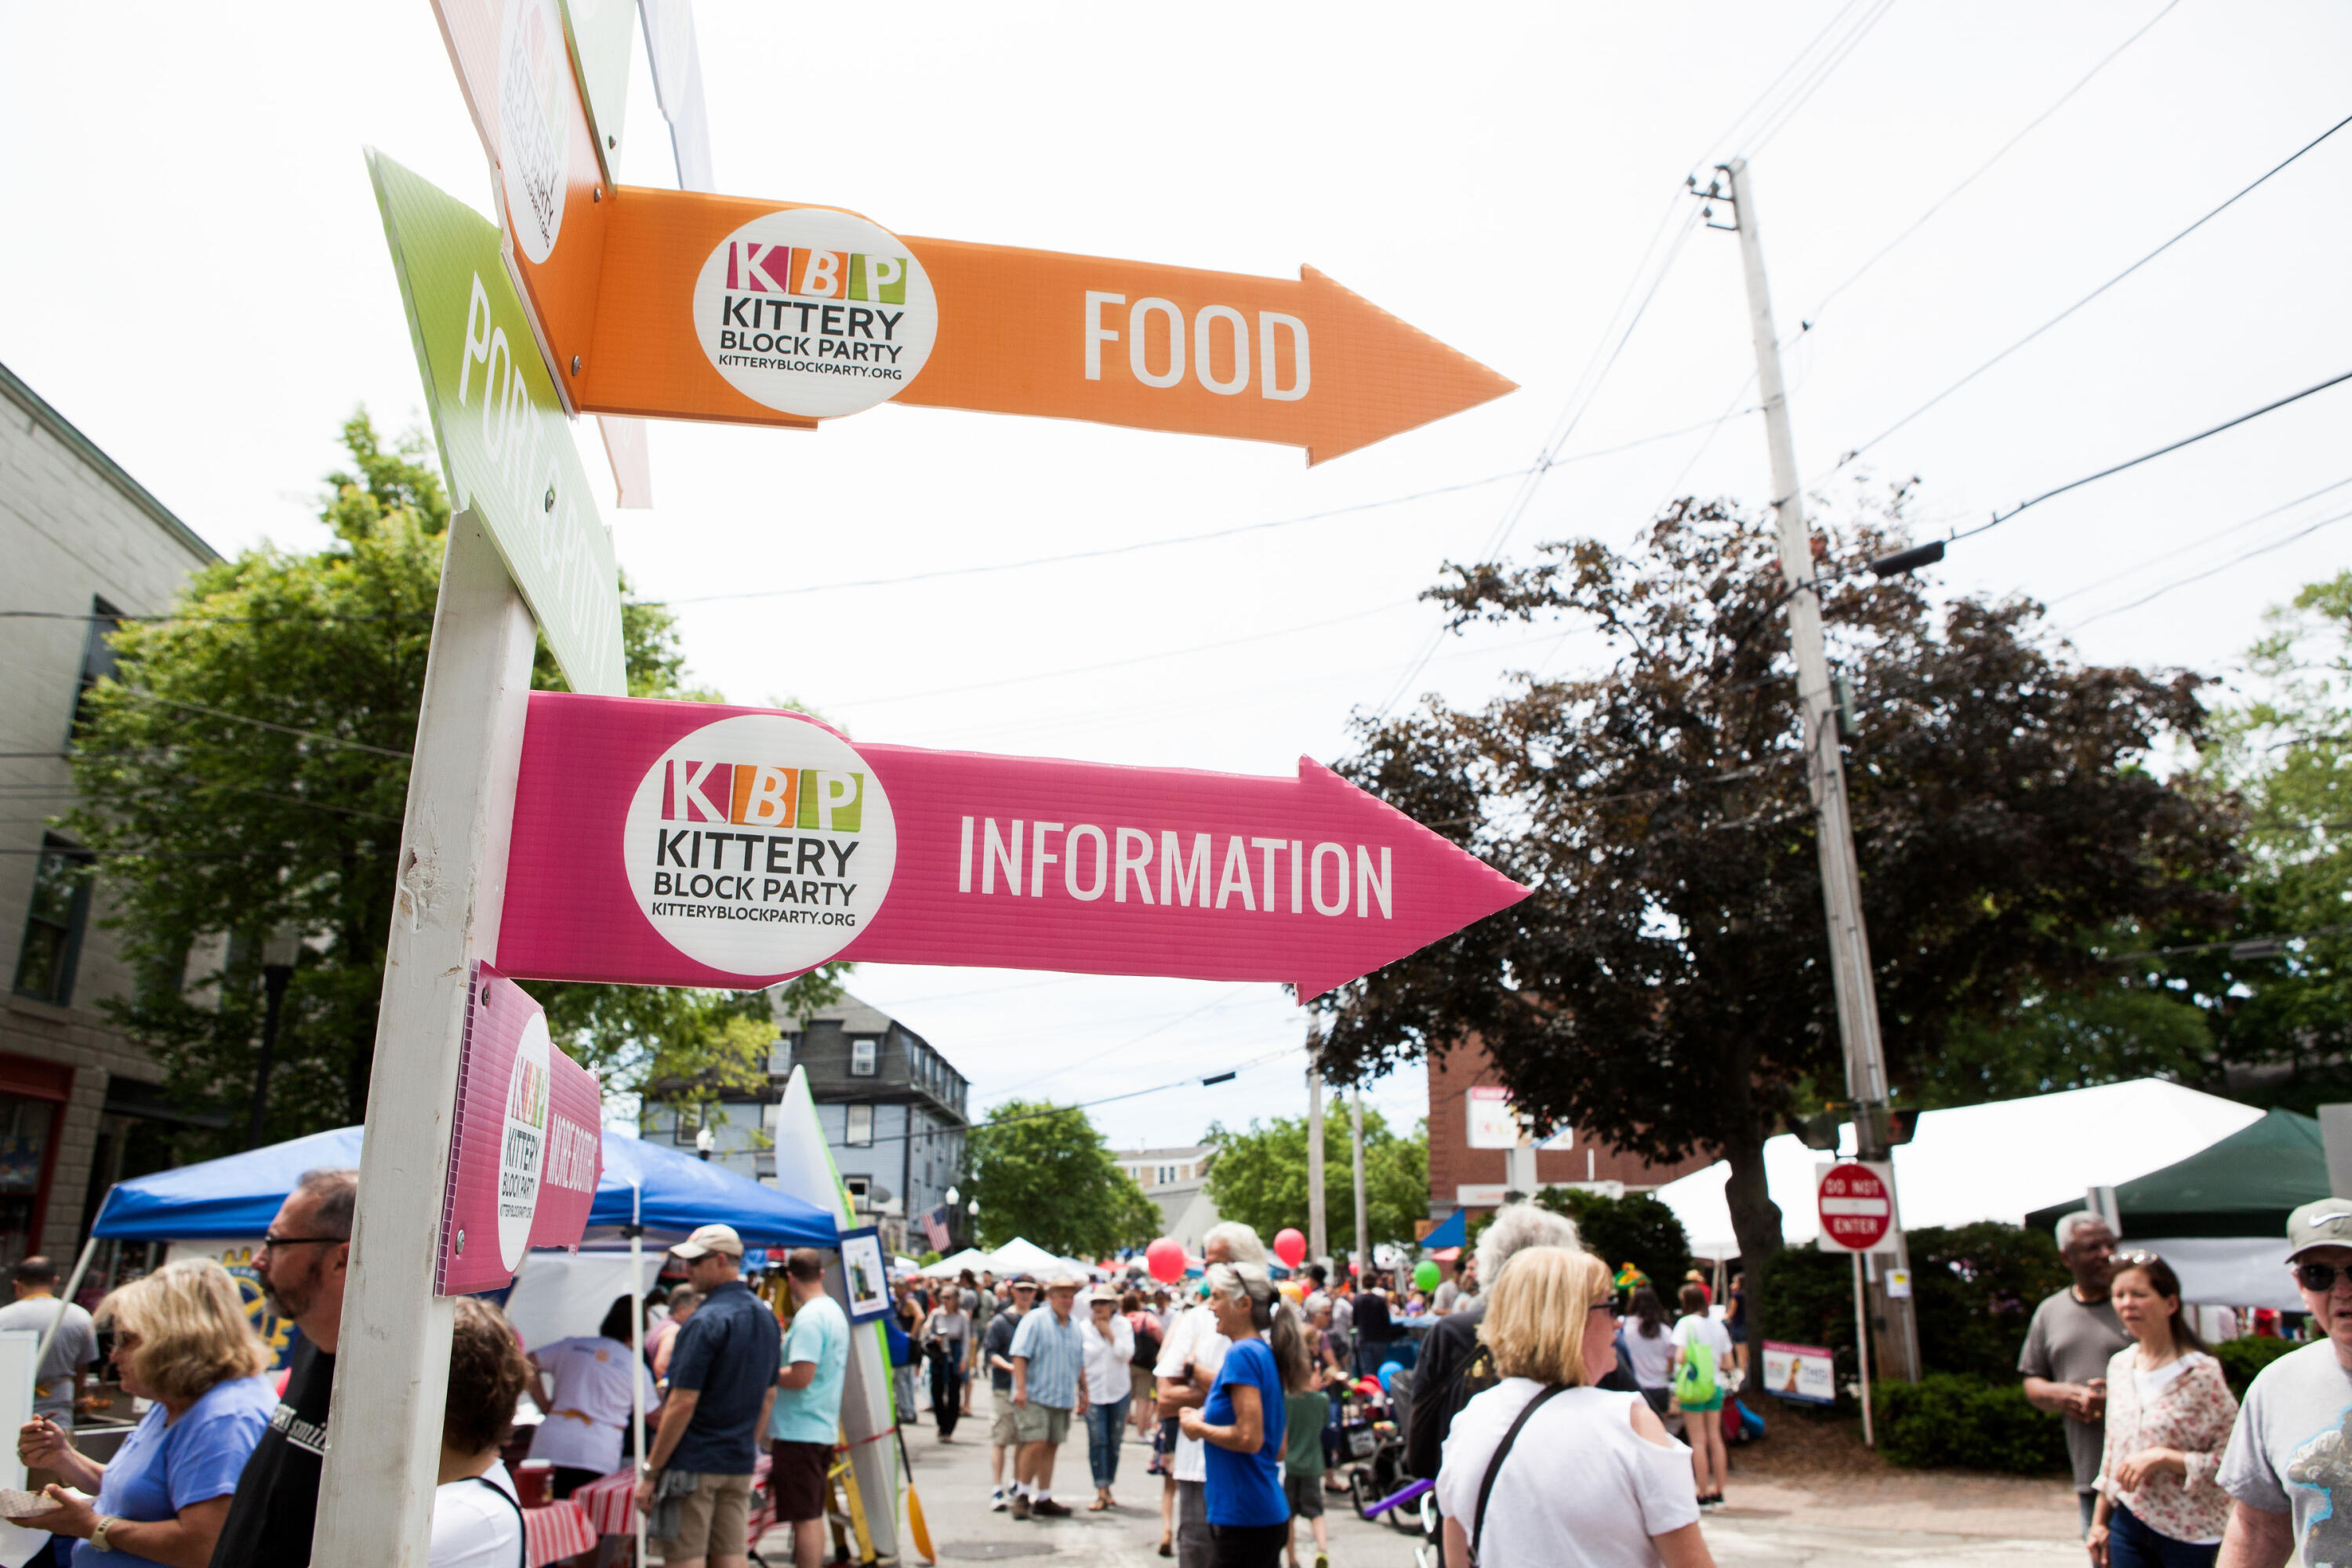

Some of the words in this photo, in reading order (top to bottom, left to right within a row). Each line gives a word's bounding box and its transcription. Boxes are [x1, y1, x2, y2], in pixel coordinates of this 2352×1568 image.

[727, 241, 907, 306] KBP
[722, 295, 905, 341] KITTERY
[719, 354, 902, 381] KITTERYBLOCKPARTY.ORG
[720, 329, 811, 357] BLOCK
[818, 339, 903, 365] PARTY
[1084, 289, 1311, 401] FOOD
[661, 759, 864, 833] KBP
[656, 828, 859, 878] KITTERY
[959, 815, 1392, 920] INFORMATION
[653, 871, 755, 902] BLOCK
[762, 877, 858, 907] PARTY
[652, 902, 855, 927] KITTERYBLOCKPARTY.ORG
[511, 1054, 547, 1130] KBP
[506, 1127, 541, 1174] KITTERY
[546, 1112, 575, 1189] MORE
[502, 1171, 521, 1199] BLOCK
[521, 1175, 535, 1201] PARTY
[1825, 1178, 1846, 1195] DO
[1851, 1178, 1880, 1196] NOT
[1833, 1217, 1879, 1235] ENTER
